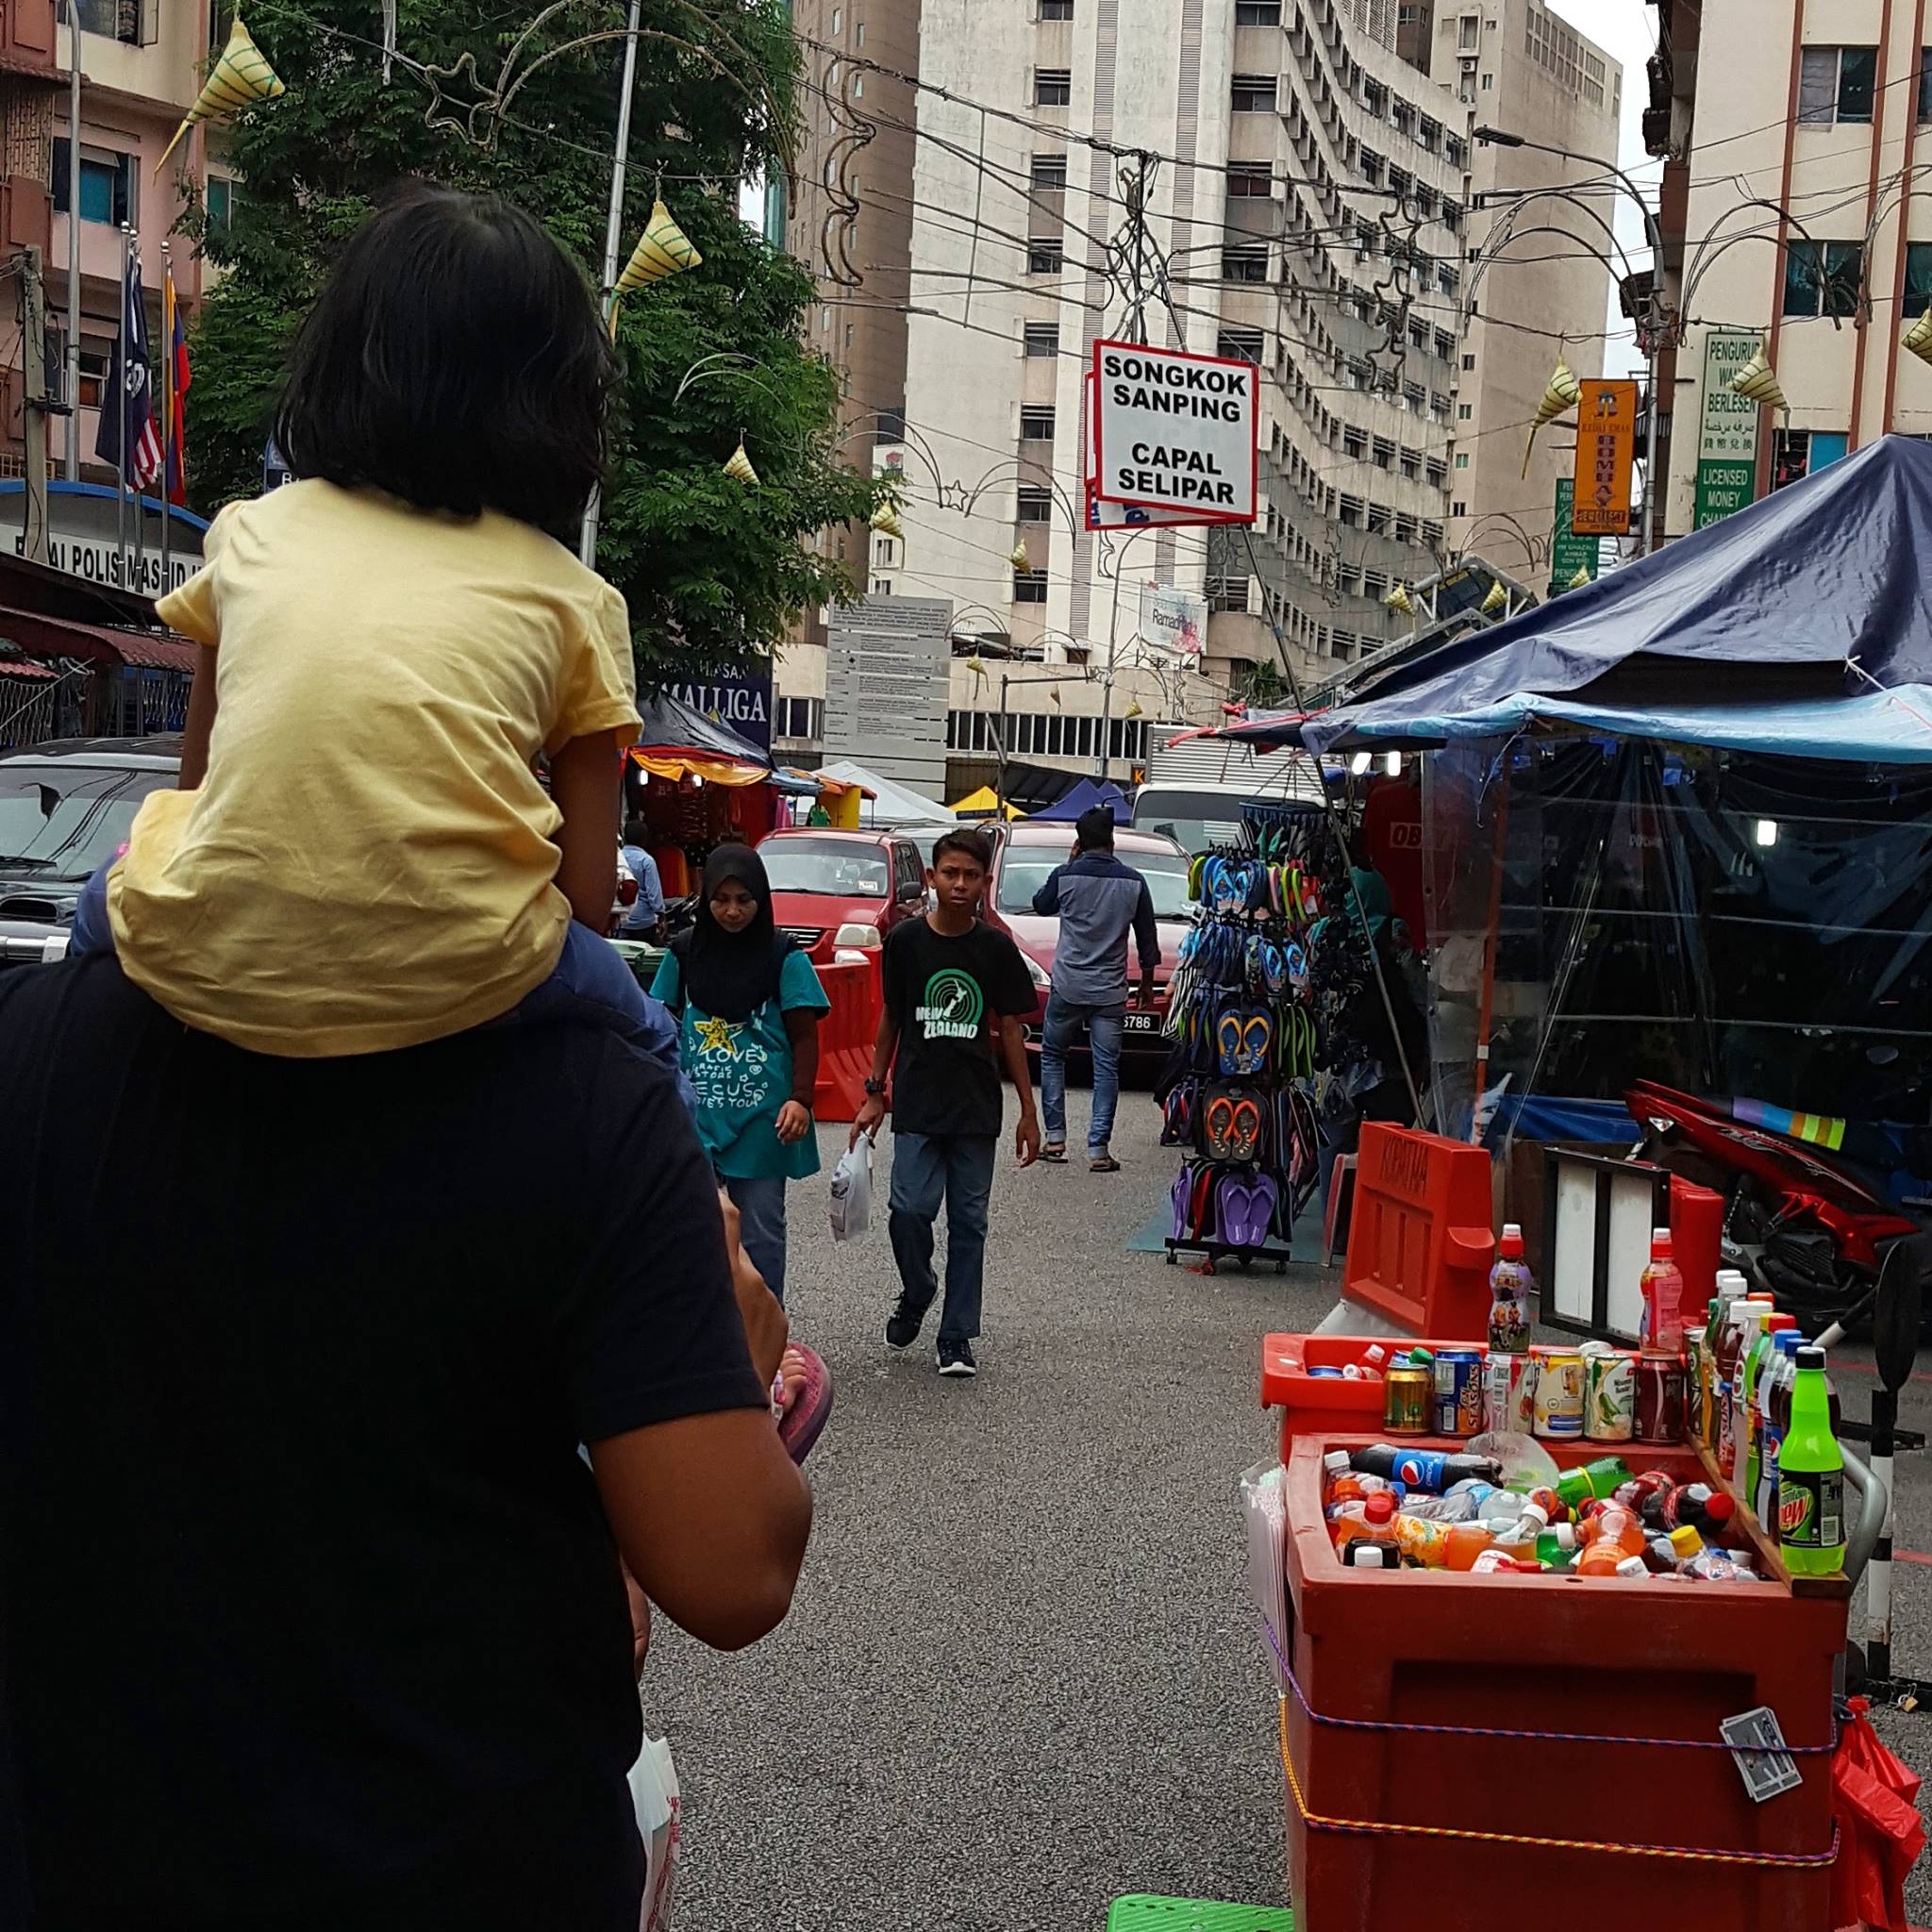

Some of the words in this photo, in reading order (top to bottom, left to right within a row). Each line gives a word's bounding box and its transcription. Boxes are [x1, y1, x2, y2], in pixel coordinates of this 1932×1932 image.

[1104, 355, 1247, 396] SONGKOK
[1113, 384, 1241, 423] SANPING
[1131, 442, 1222, 475] CAPAL
[1118, 468, 1235, 505] SELIPAR
[1703, 468, 1748, 486] LICENSED
[1707, 491, 1741, 508] MONEY
[73, 544, 120, 584] POLIS
[915, 1007, 944, 1022] NEW
[924, 1021, 978, 1040] ZEALAND
[706, 1048, 758, 1064] LOVE
[1468, 1363, 1480, 1427] SEASONS
